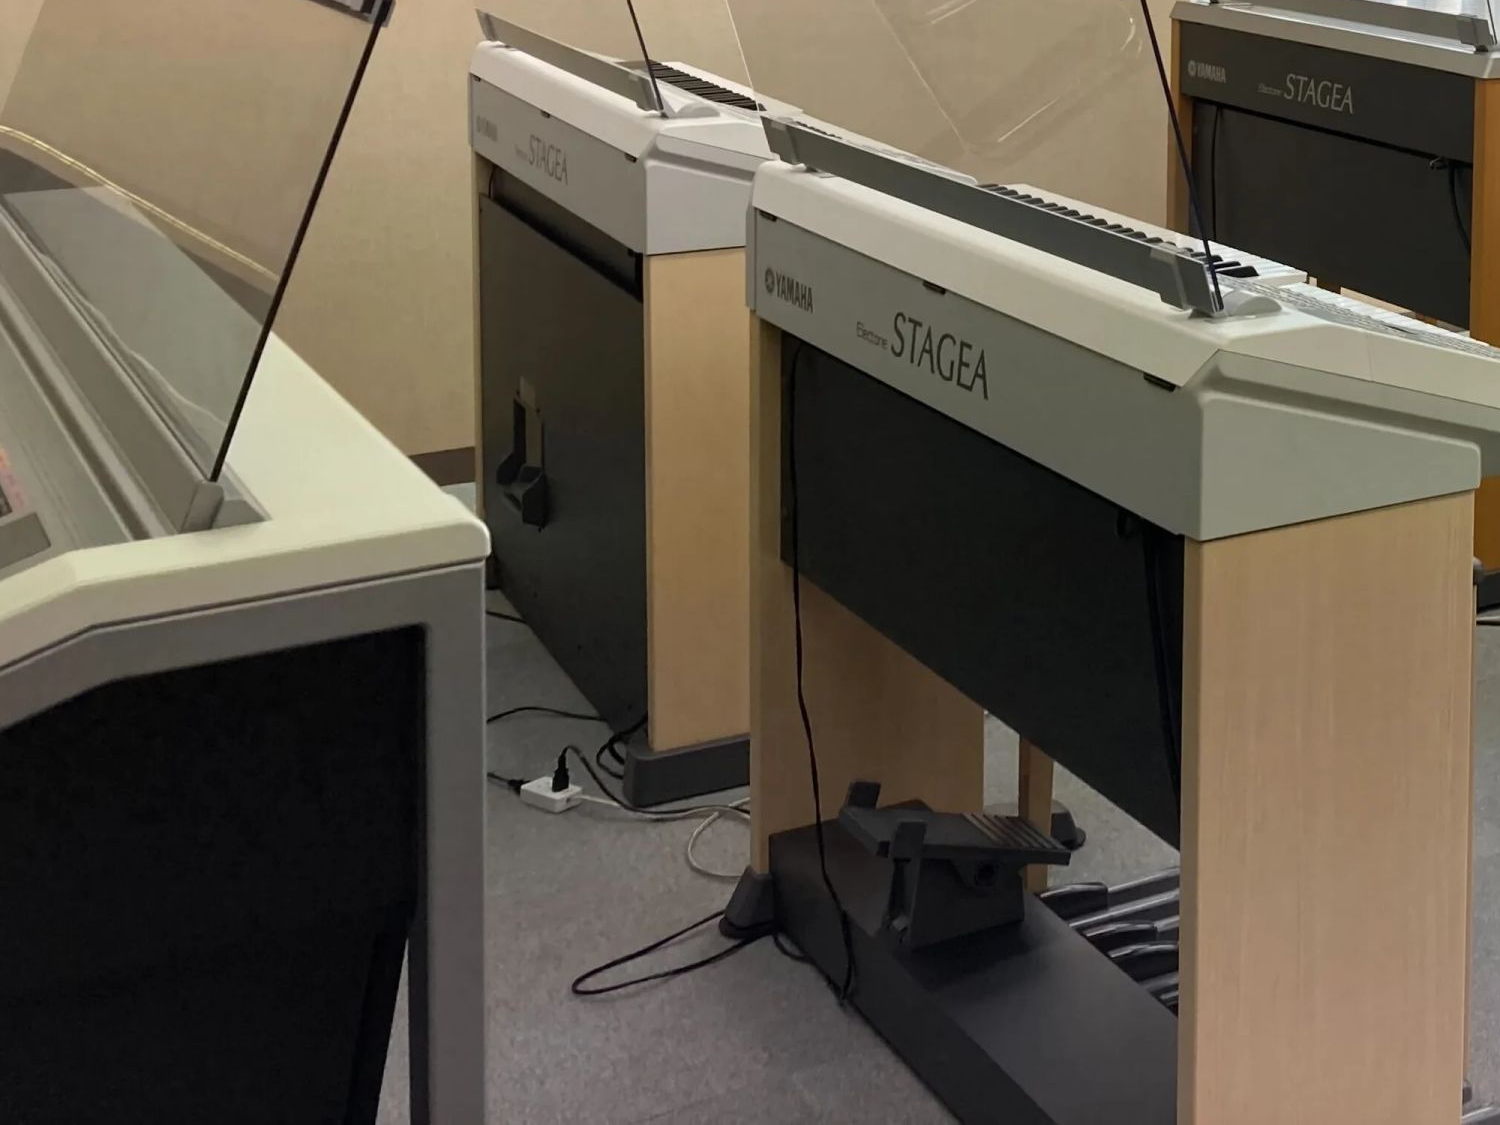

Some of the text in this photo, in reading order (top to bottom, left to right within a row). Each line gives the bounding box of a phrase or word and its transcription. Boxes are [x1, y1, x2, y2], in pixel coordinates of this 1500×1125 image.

[1283, 73, 1354, 114] STAGEA
[774, 271, 814, 314] YAMAHA
[890, 312, 989, 401] STAGEA
